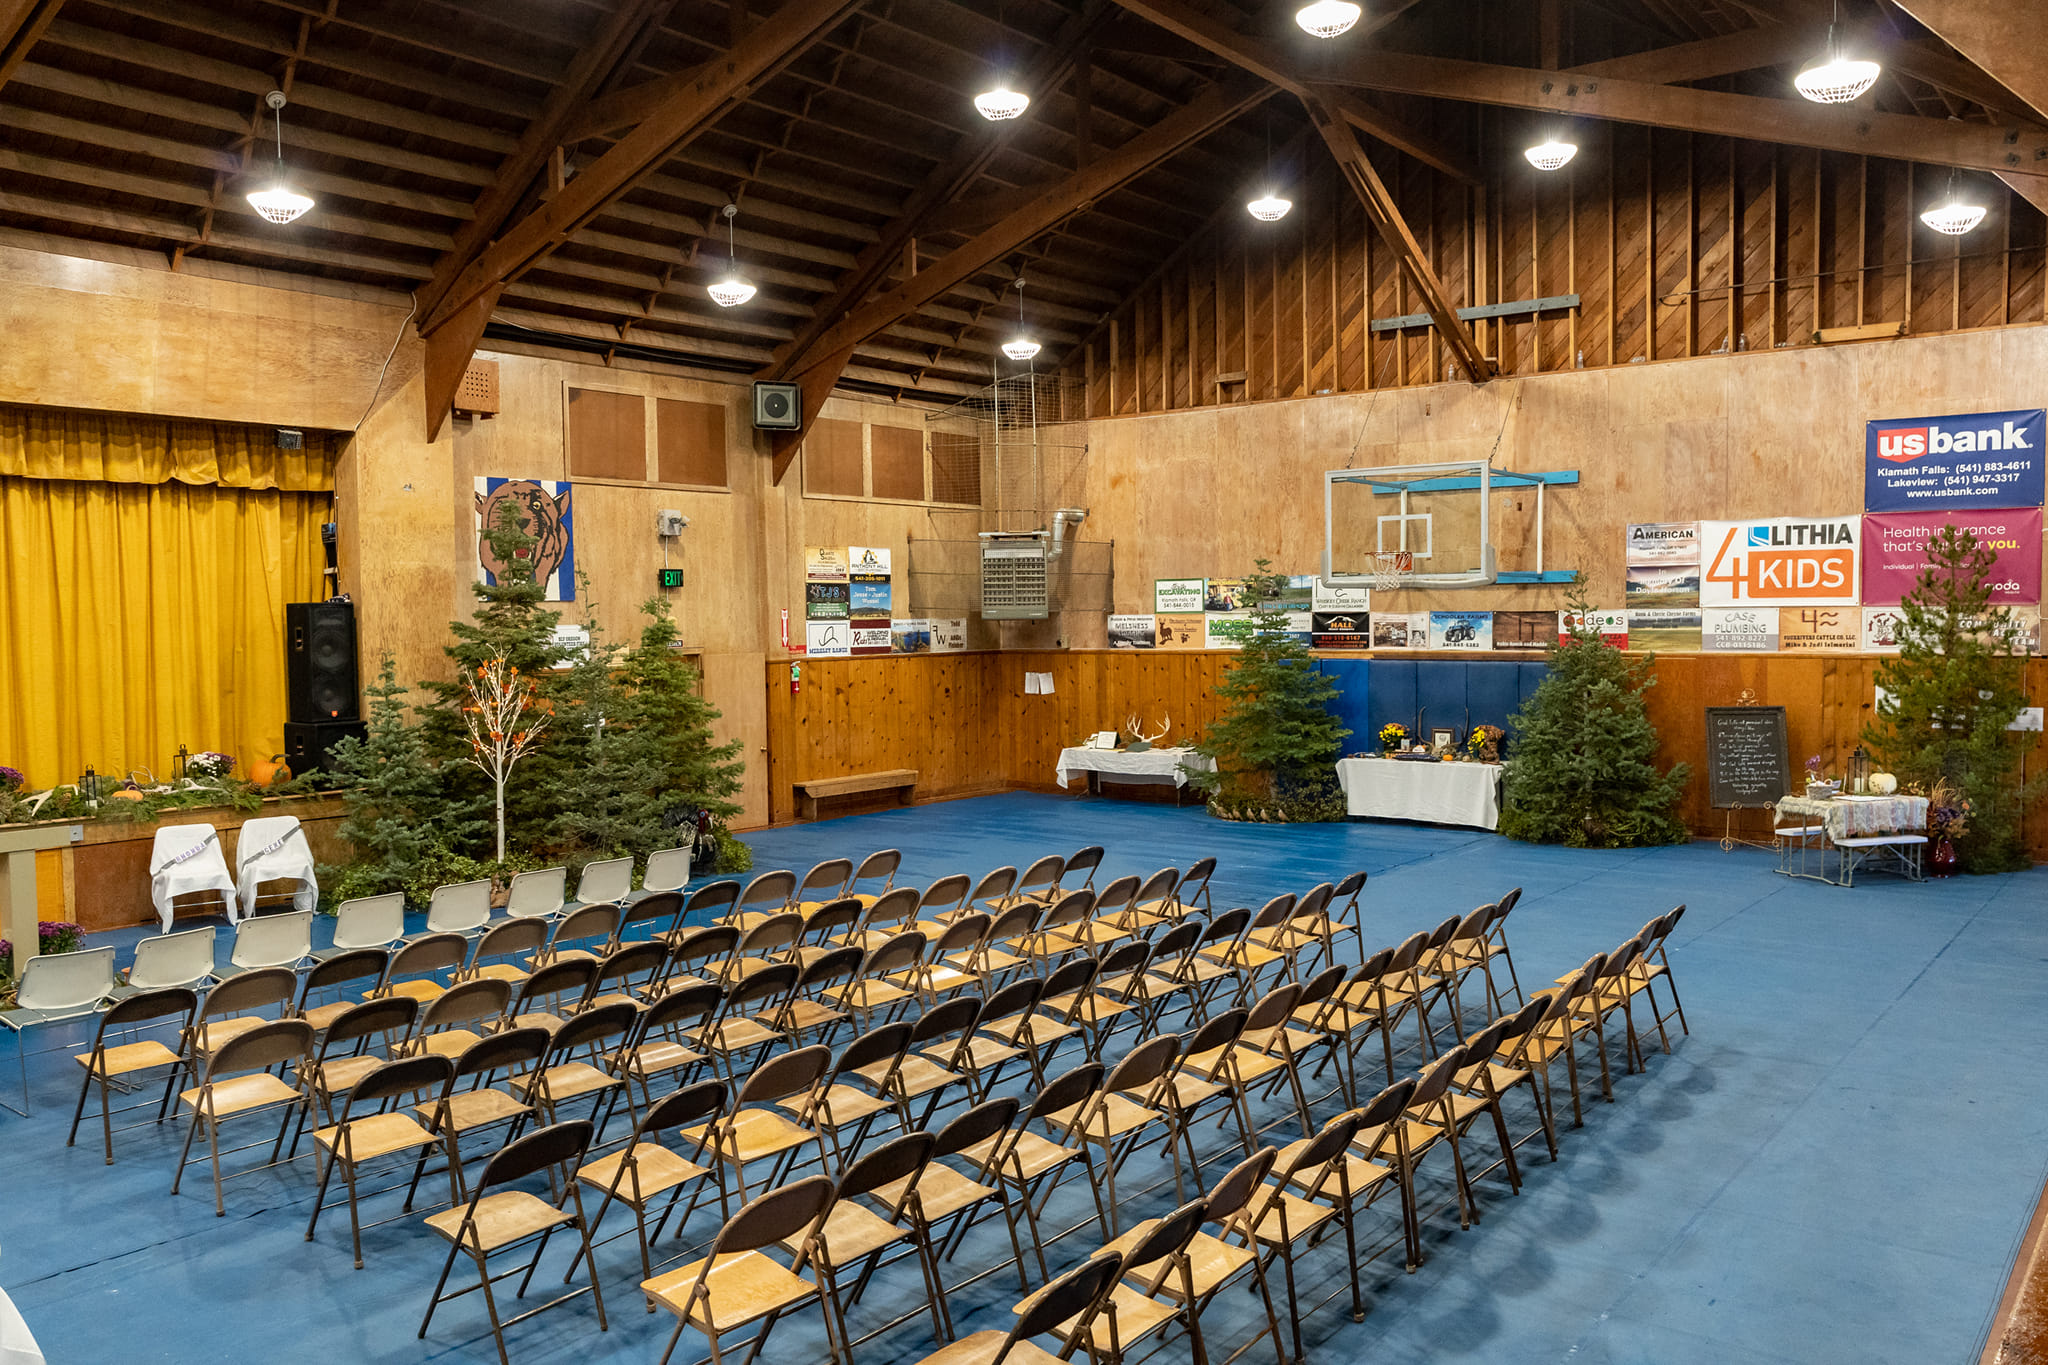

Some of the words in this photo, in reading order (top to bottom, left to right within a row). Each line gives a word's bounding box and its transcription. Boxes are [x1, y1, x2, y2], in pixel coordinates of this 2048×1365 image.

[1878, 466, 1918, 476] Klamath
[1922, 466, 1950, 475] Falls:
[1956, 463, 1982, 474] (541)
[1984, 461, 2031, 472] 883-4611
[1888, 478, 1938, 488] Lakeview:
[1944, 476, 1970, 486] (541)
[1972, 473, 2020, 484] 947-3317
[1907, 487, 1998, 498] www.usbank.com
[1633, 528, 1693, 540] AMERICAN
[1772, 524, 1853, 545] LITHIA
[1883, 526, 1930, 538] Health
[1934, 525, 2006, 537] inurance
[1883, 541, 1923, 552] that's
[1987, 540, 2020, 550] you.
[1706, 528, 1748, 599] 4
[1759, 558, 1845, 588] KIDS
[665, 571, 681, 586] EXIT
[1725, 612, 1756, 623] CASE
[1209, 620, 1253, 630] MOSS
[1714, 624, 1767, 633] PLUMBING
